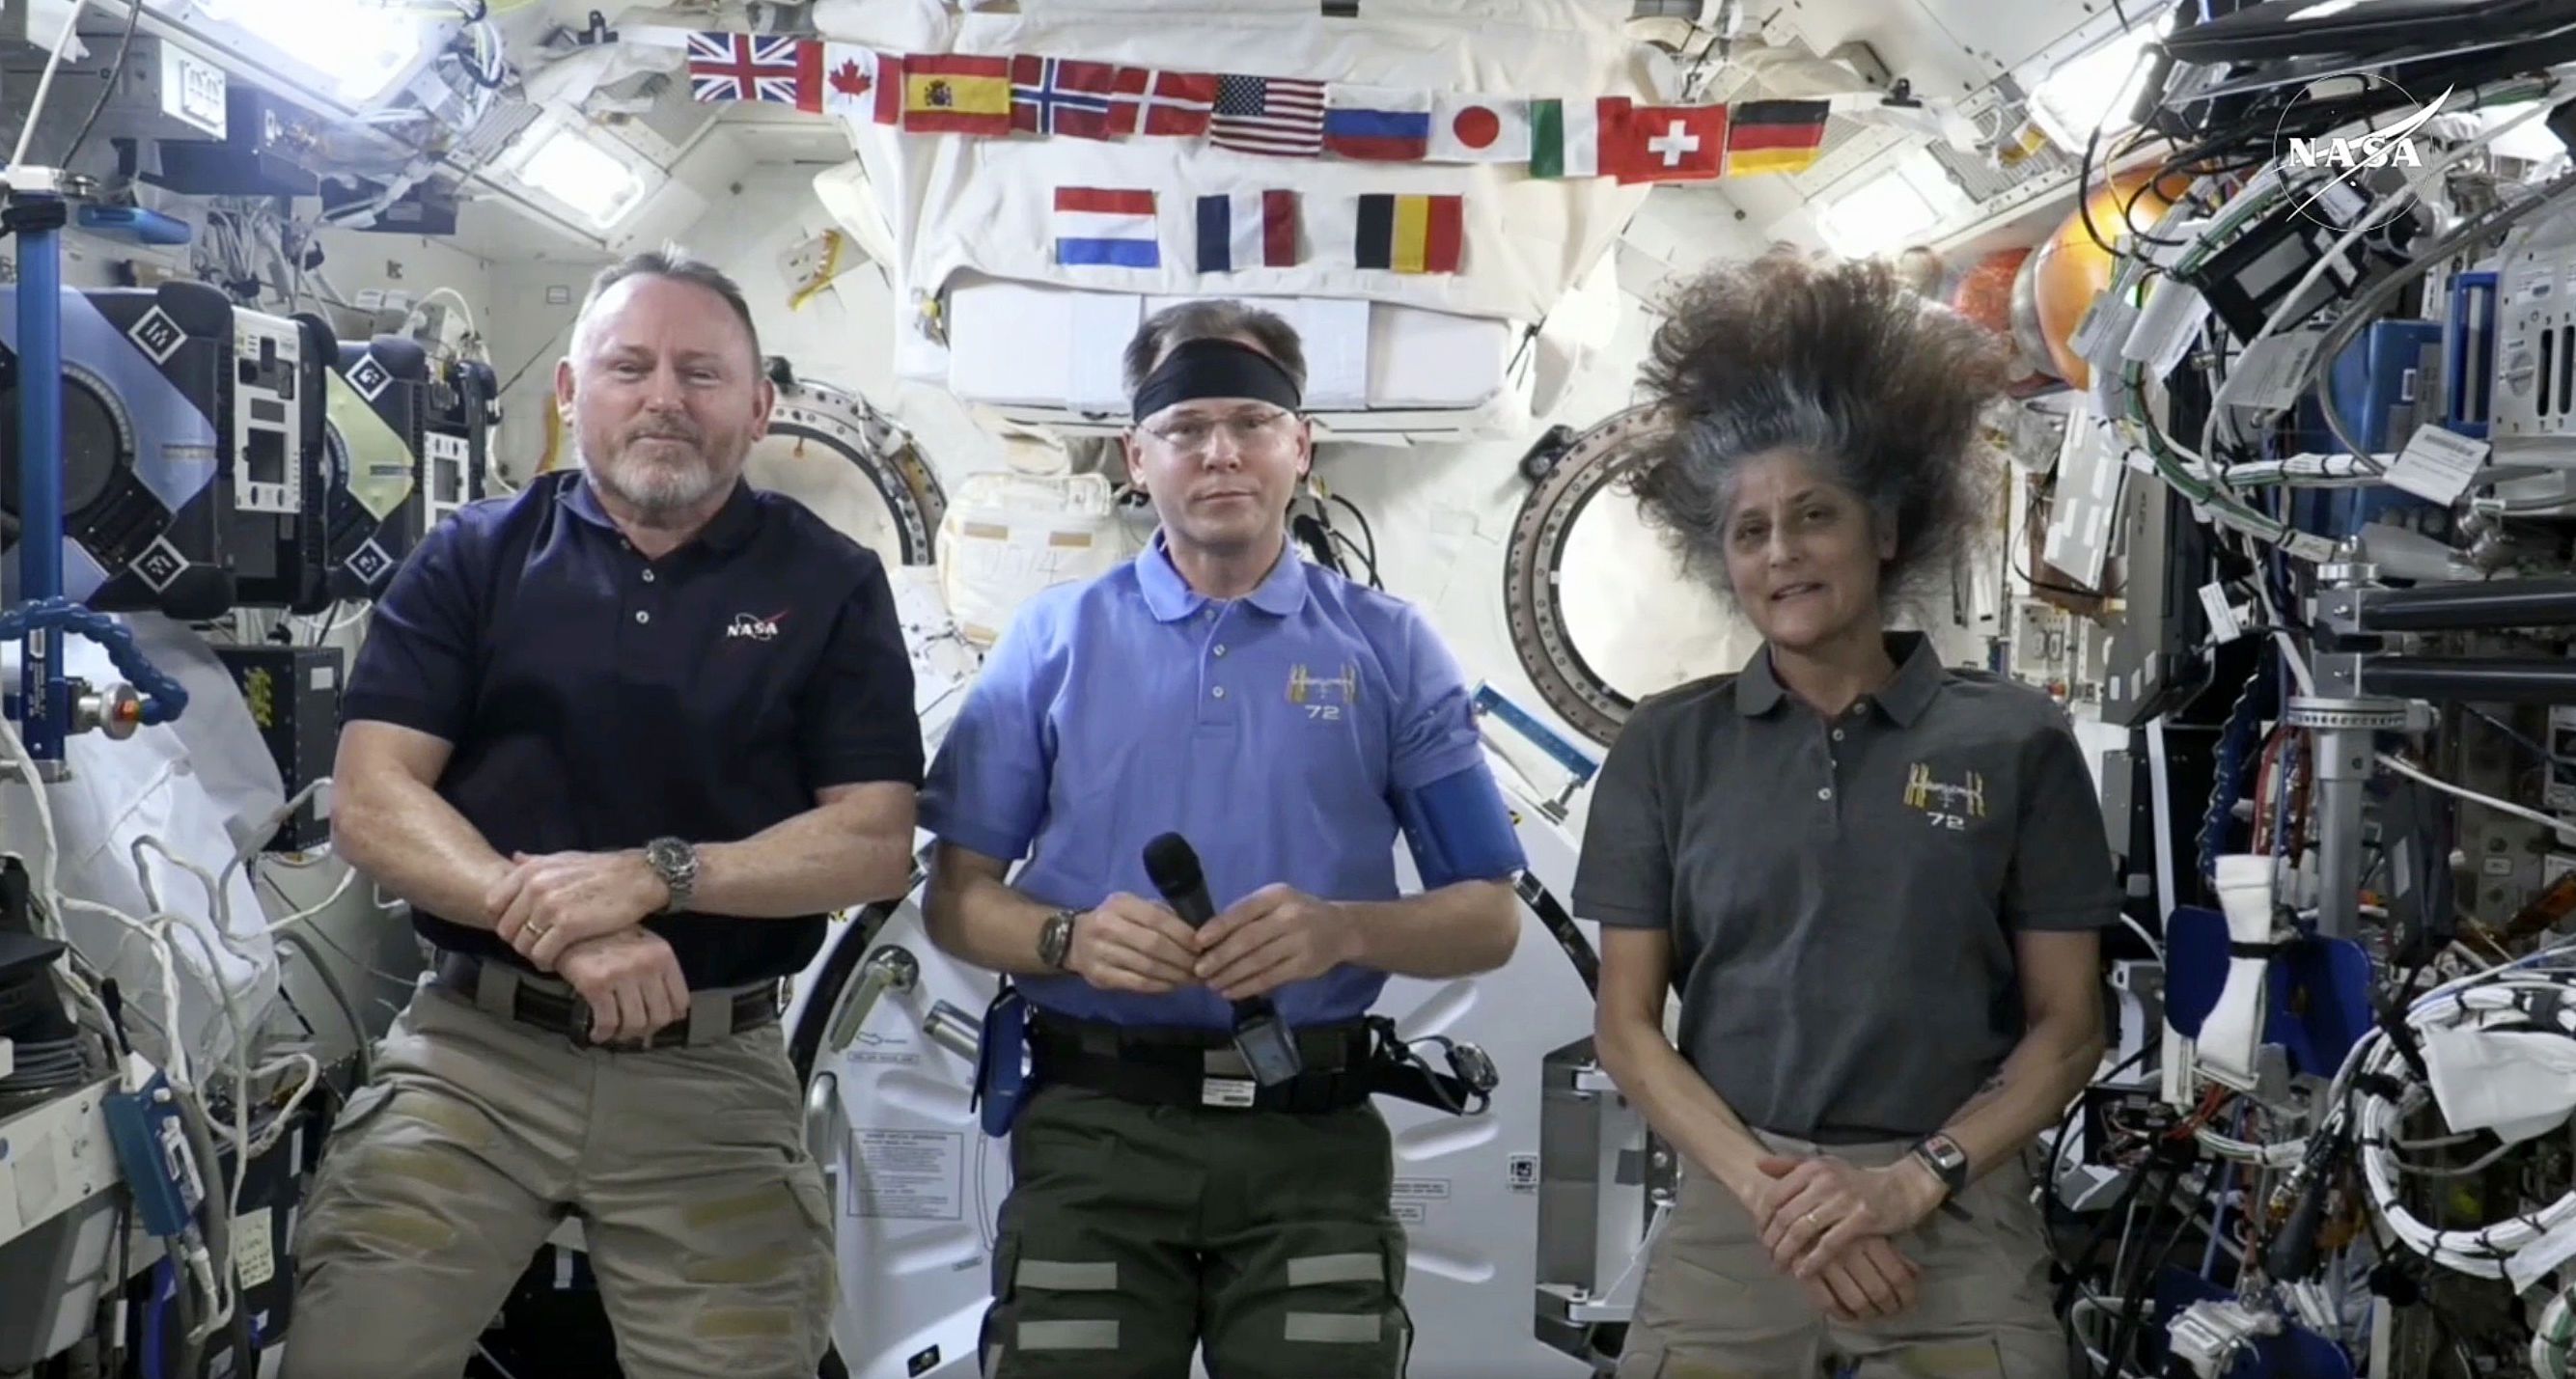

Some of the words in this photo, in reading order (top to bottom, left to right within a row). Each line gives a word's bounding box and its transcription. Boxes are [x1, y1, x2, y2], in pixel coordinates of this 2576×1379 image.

[727, 621, 779, 637] NASA
[1304, 704, 1341, 720] 72
[1926, 812, 1966, 830] 72
